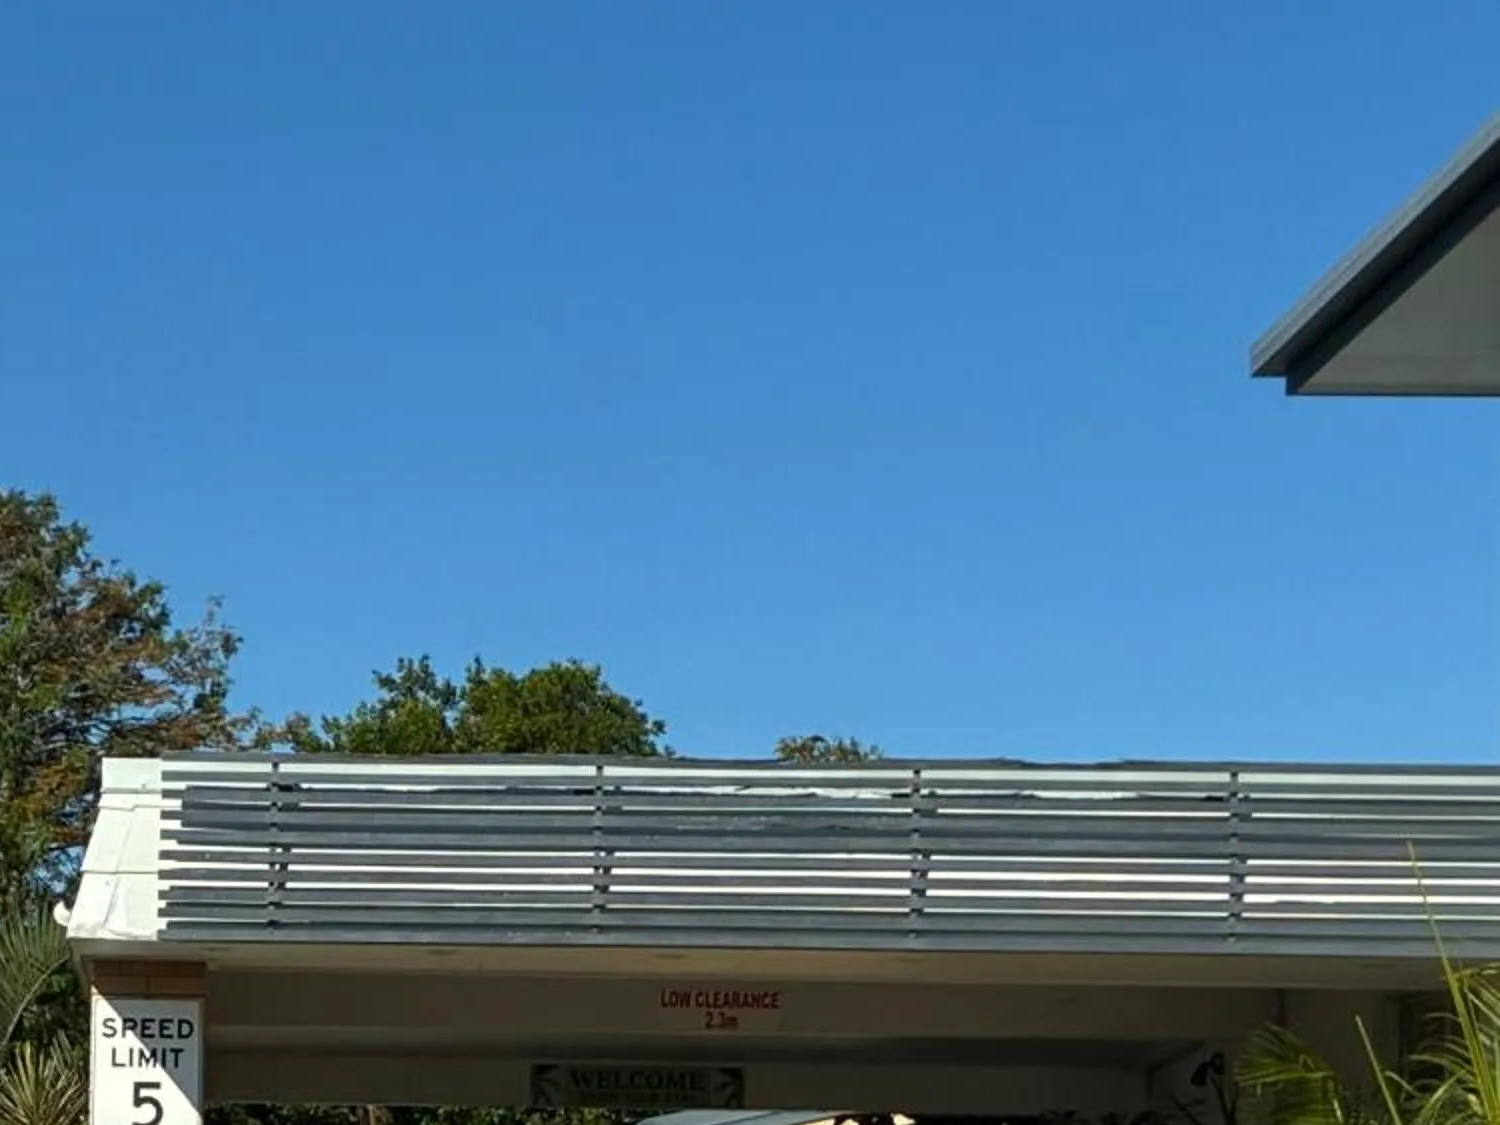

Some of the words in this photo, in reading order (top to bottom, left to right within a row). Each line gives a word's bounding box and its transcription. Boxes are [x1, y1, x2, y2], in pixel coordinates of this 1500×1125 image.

[660, 991, 691, 1008] LOW
[695, 991, 780, 1010] CLEARANCE
[102, 1017, 195, 1039] SPEED
[111, 1047, 185, 1069] LIMIT
[569, 1069, 706, 1091] WELCOME
